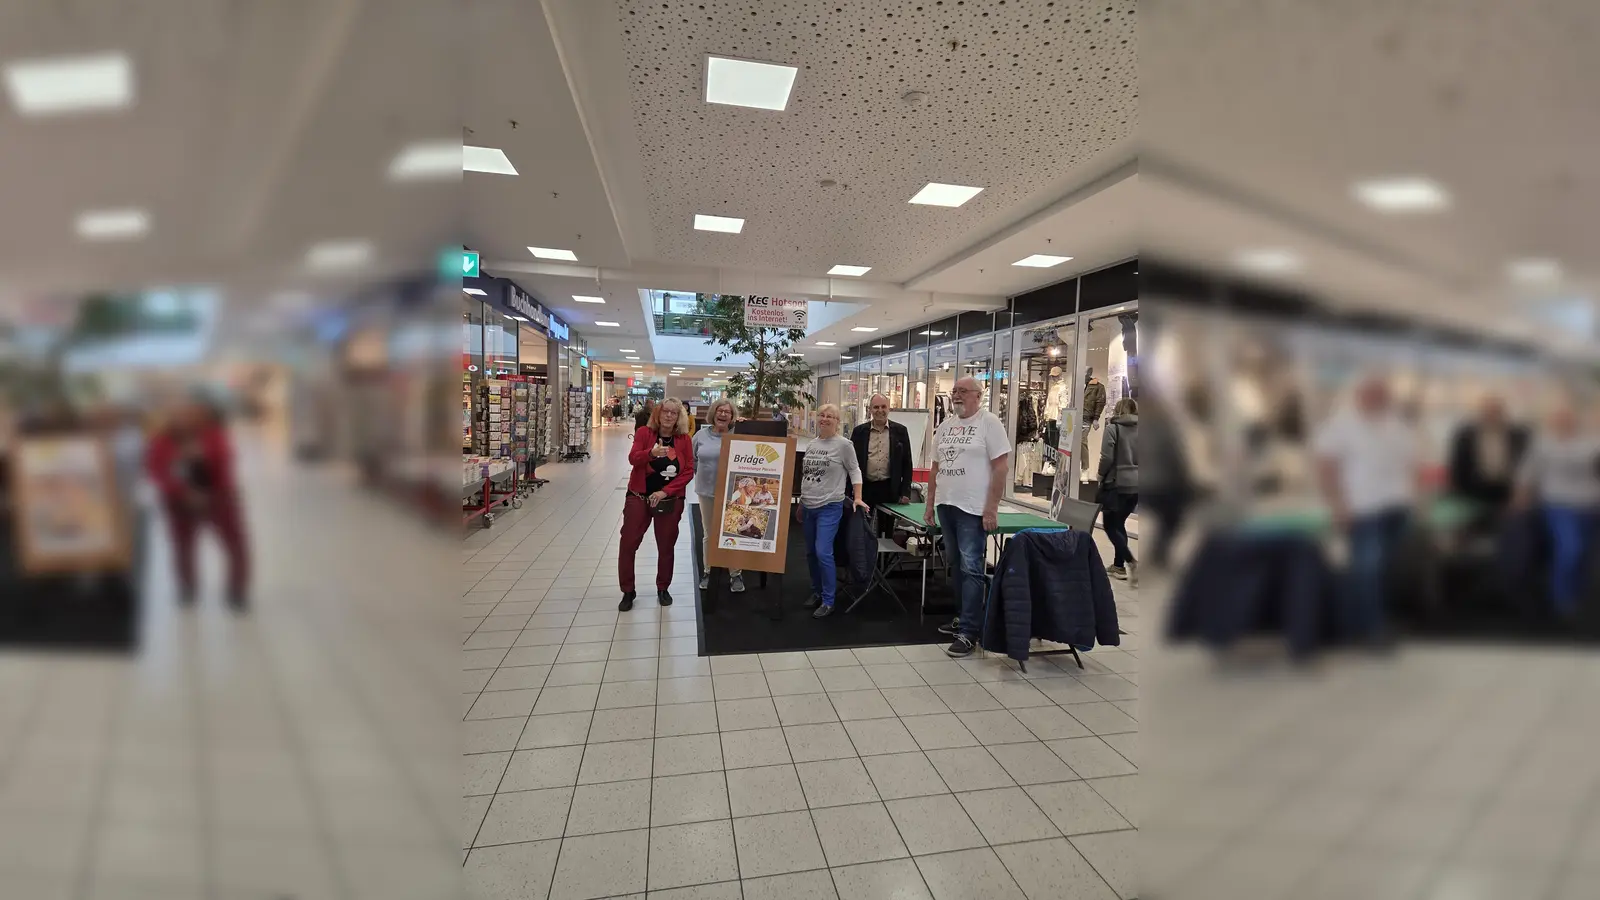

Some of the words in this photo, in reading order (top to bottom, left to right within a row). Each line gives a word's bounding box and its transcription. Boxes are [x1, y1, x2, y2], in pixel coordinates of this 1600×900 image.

[748, 294, 769, 306] KEC
[771, 297, 807, 309] Hotspot
[751, 308, 785, 317] Kostenlos
[758, 315, 788, 324] Internet!
[733, 454, 765, 466] Bridge
[947, 467, 966, 477] MUCH
